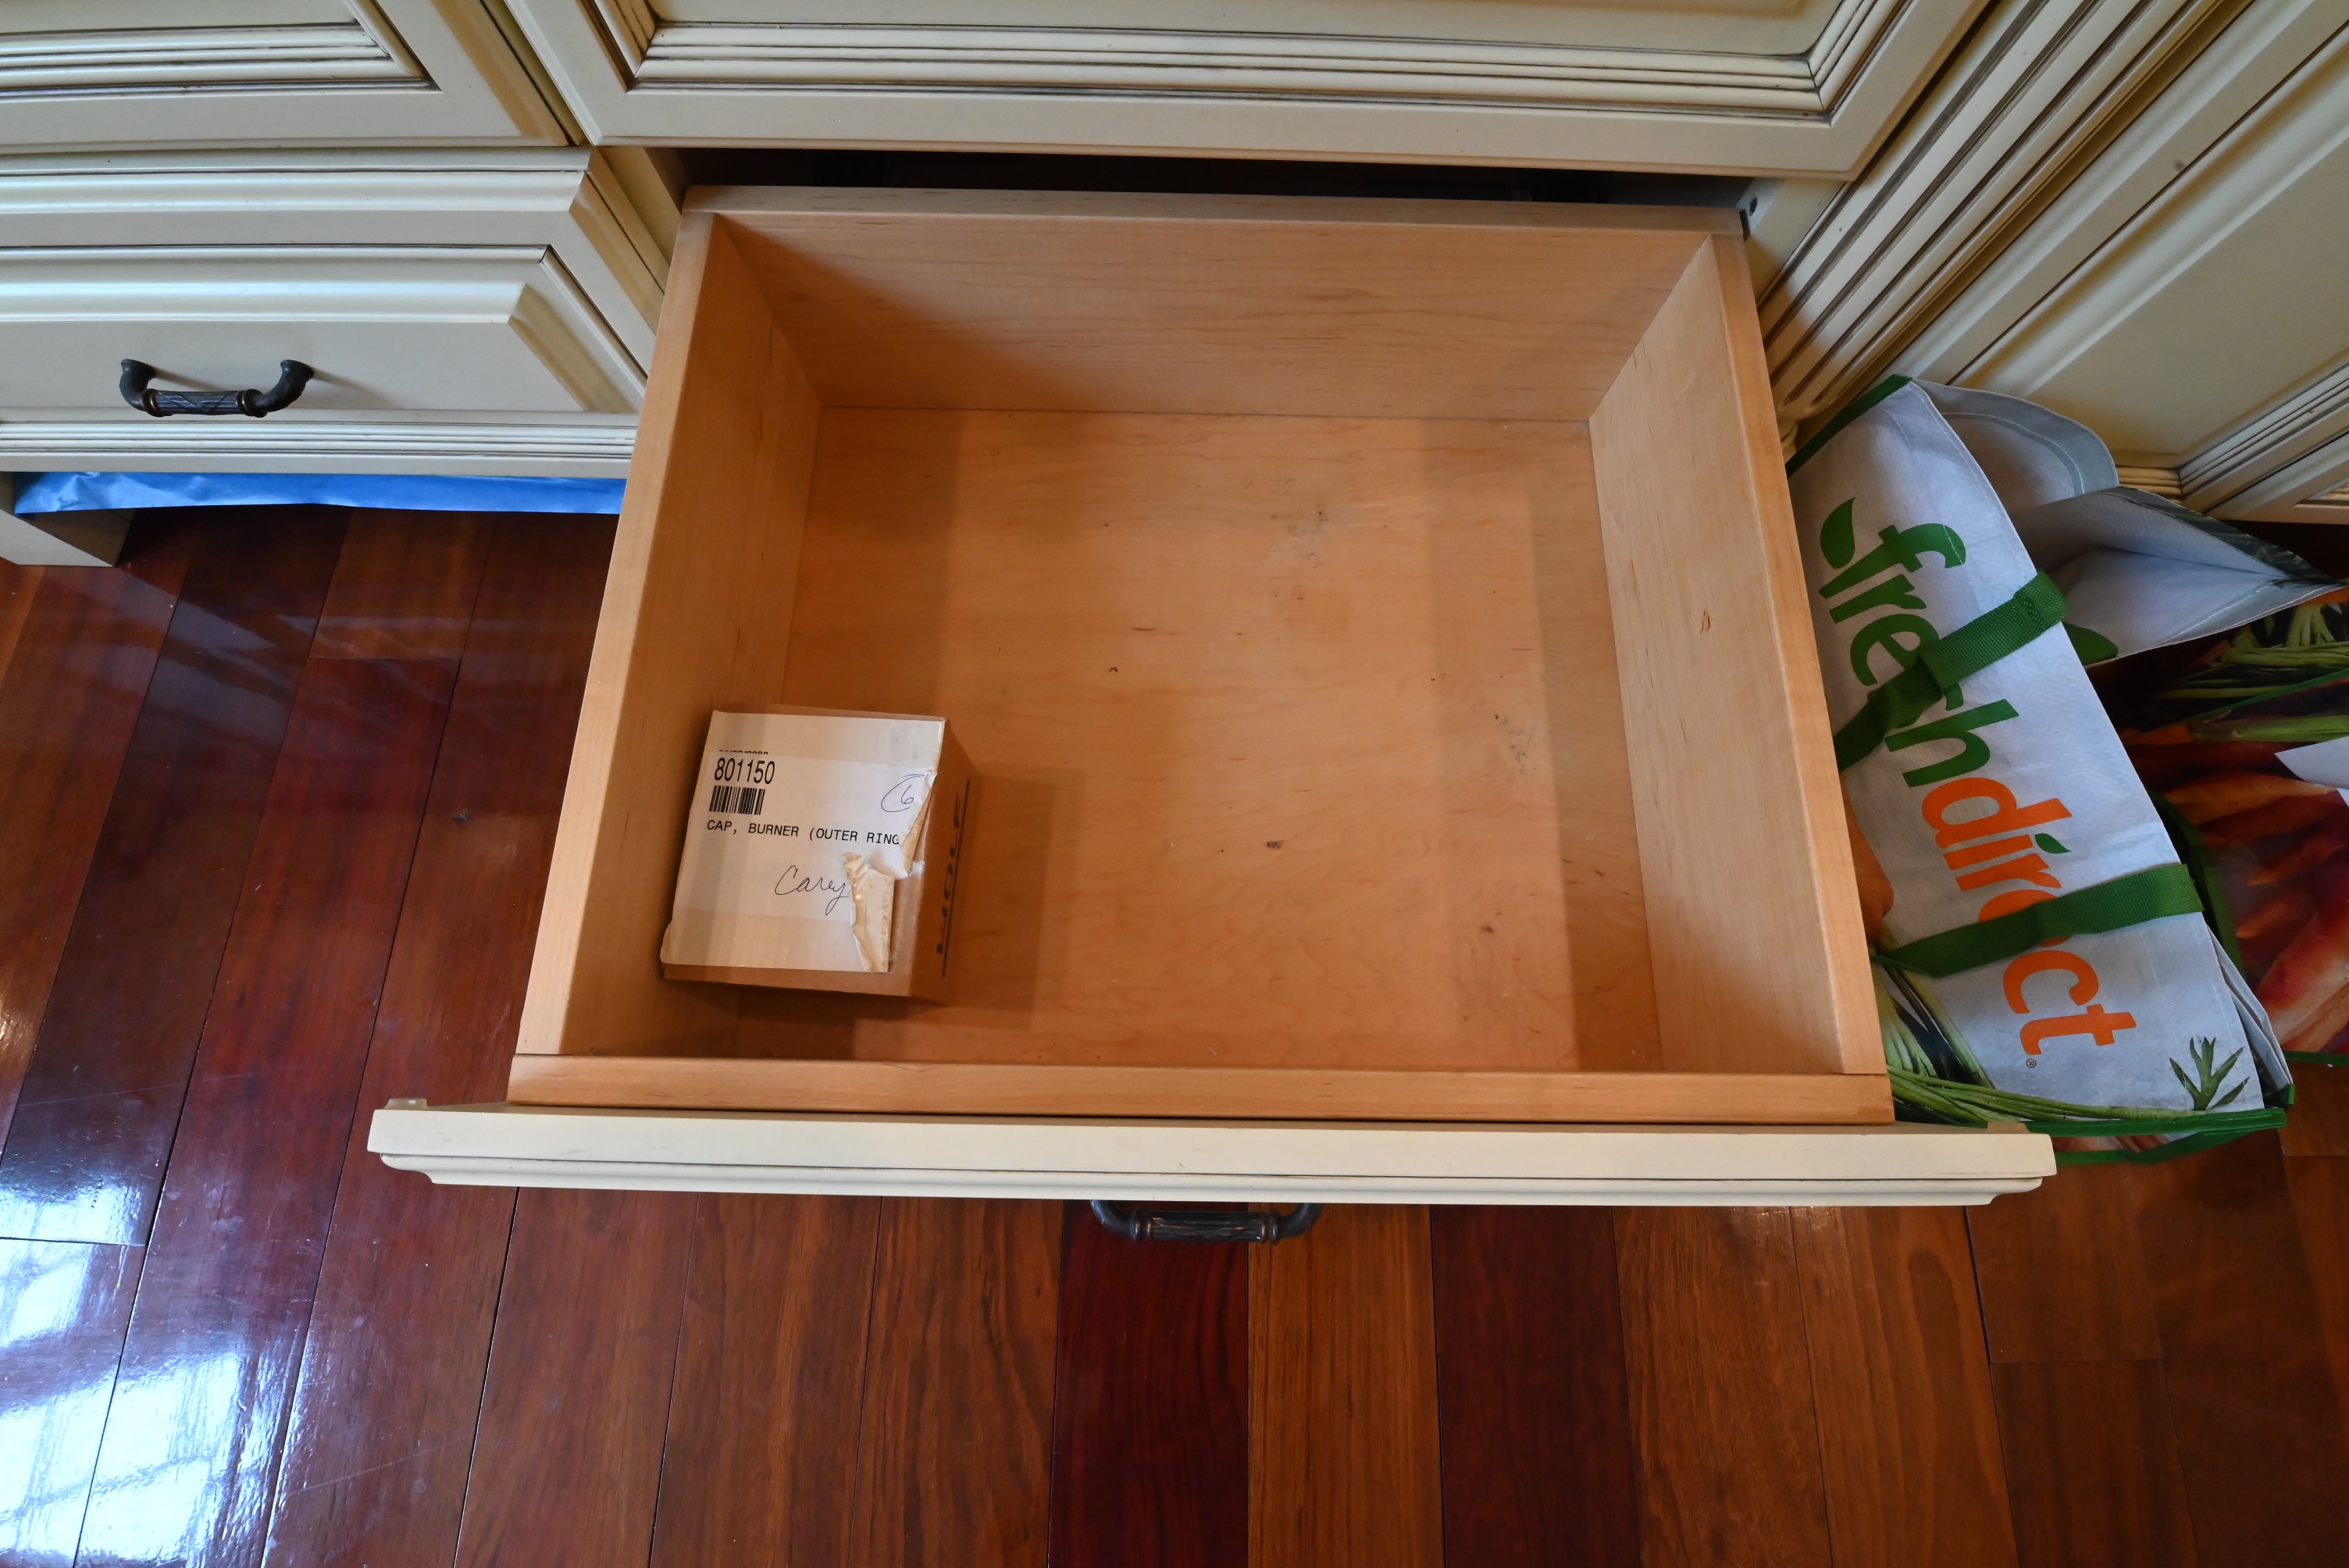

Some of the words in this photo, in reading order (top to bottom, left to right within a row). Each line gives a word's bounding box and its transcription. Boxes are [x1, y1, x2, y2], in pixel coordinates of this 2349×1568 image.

[714, 757, 775, 785] 801150
[1818, 522, 2137, 1056] frehdirct
[707, 819, 737, 835] CAP,
[747, 822, 800, 837] BURNER
[809, 828, 858, 842] (OUTER
